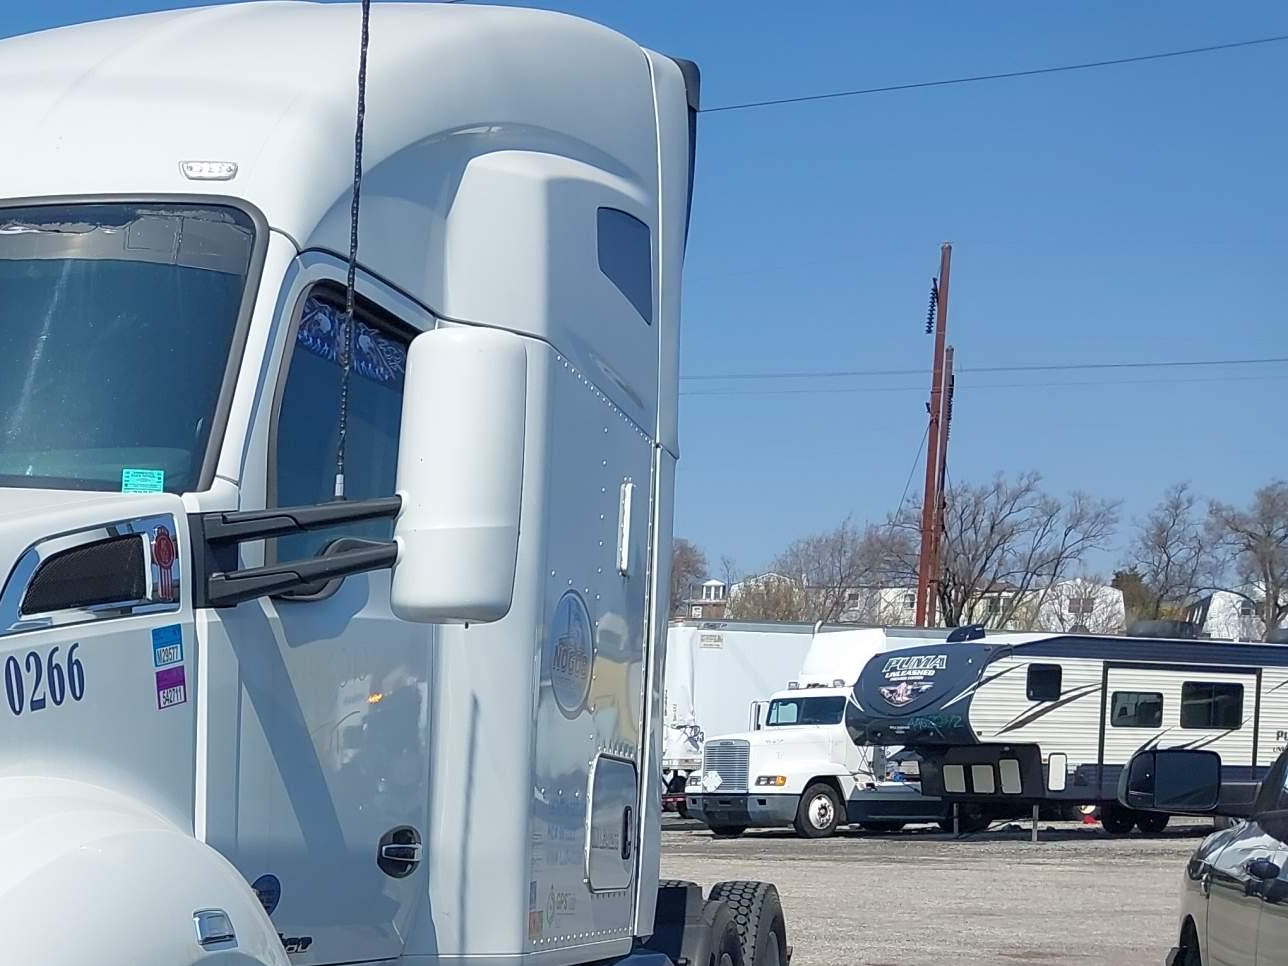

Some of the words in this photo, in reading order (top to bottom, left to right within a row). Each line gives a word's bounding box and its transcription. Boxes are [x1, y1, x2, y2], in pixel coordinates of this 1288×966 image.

[881, 654, 948, 673] PUMA
[4, 642, 85, 716] 0266
[884, 669, 936, 679] UNLEASHED
